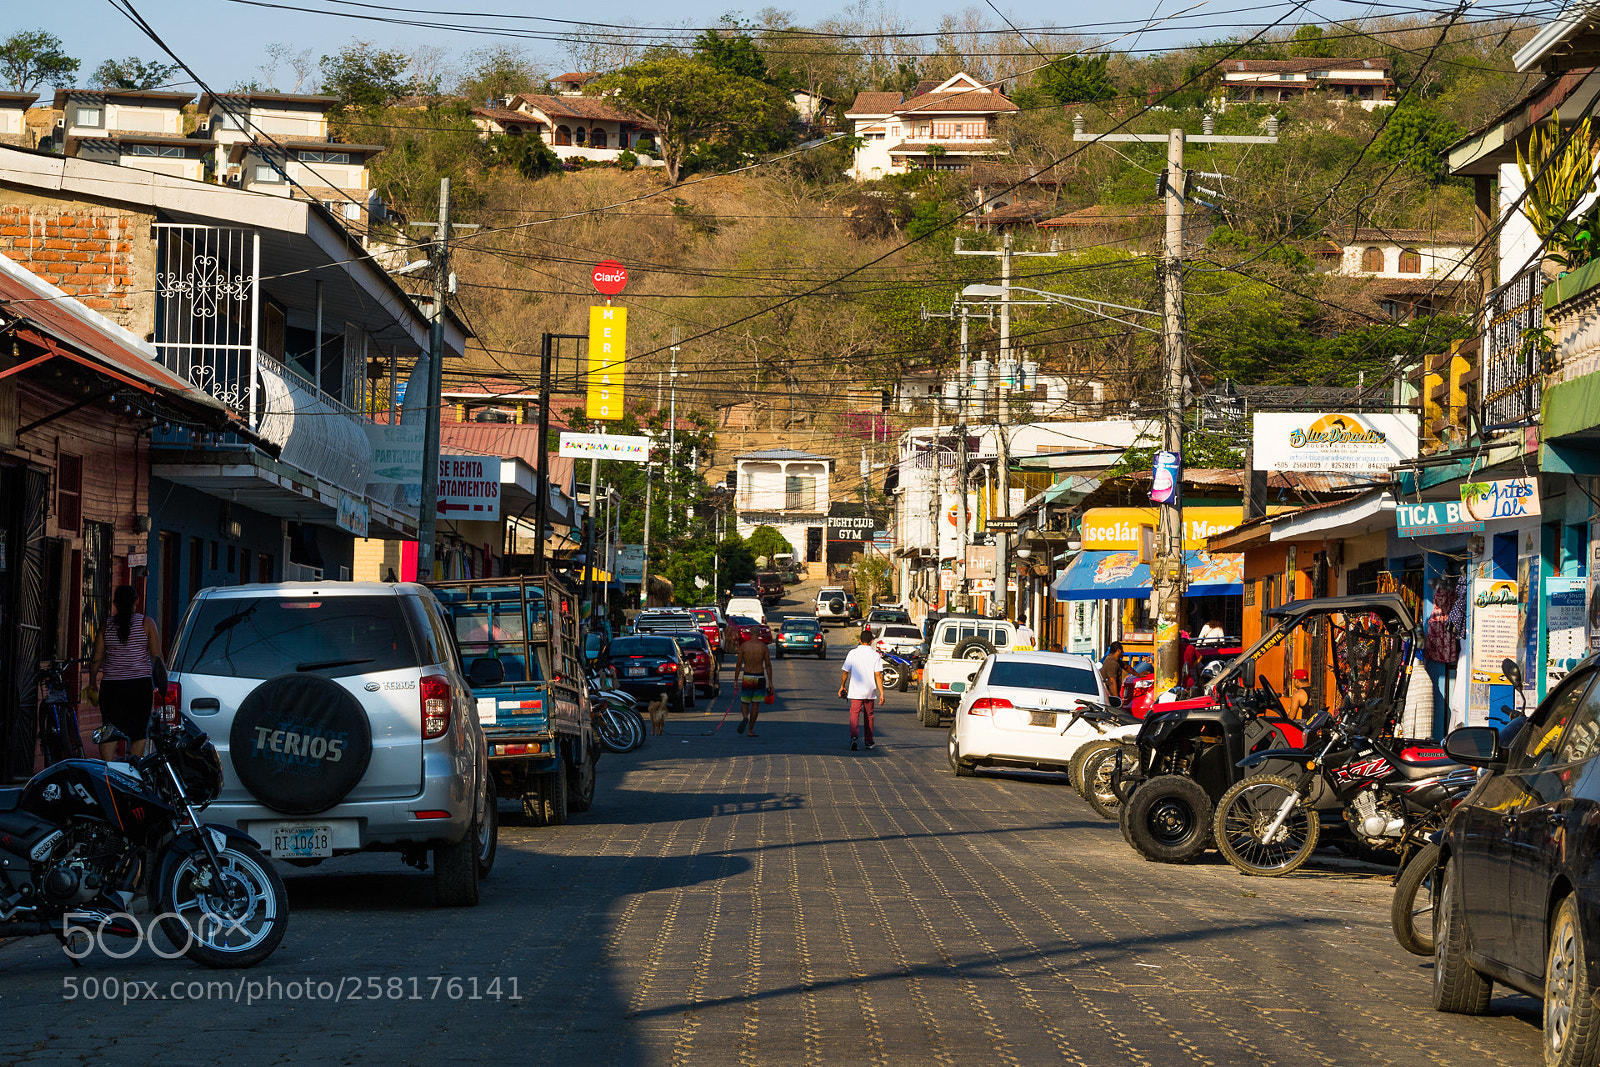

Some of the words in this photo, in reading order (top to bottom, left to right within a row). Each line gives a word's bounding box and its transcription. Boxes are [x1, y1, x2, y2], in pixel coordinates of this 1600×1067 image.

[594, 271, 622, 282] Claro
[600, 310, 613, 416] MERCADO
[565, 441, 583, 449] SAN
[453, 461, 483, 478] RENTA
[1481, 479, 1534, 500] Artes
[828, 517, 853, 528] FIGHT
[853, 517, 874, 528] CLUB
[1397, 505, 1438, 526] TICA
[838, 529, 862, 540] GYM
[1403, 528, 1439, 536] TRAVEL
[1445, 523, 1481, 534] AGENCY
[1263, 632, 1285, 650] RENTAL
[383, 680, 415, 690] TERIOS
[254, 726, 343, 762] TERIOS
[294, 835, 328, 850] 10618
